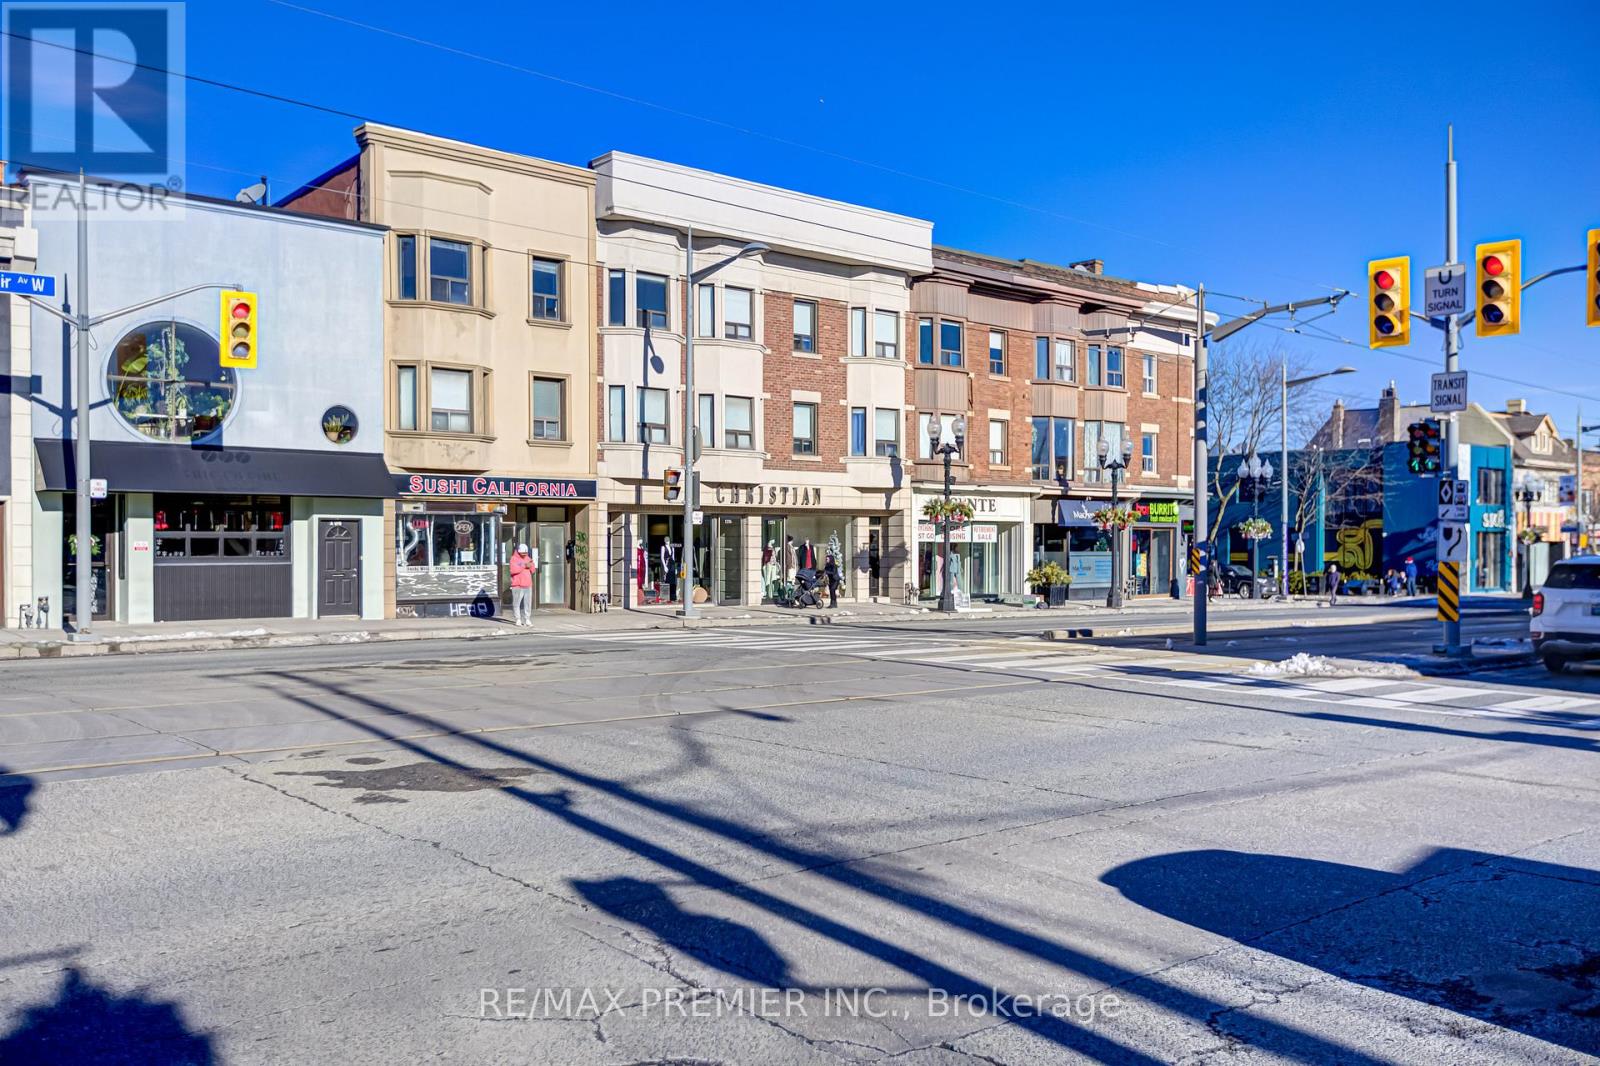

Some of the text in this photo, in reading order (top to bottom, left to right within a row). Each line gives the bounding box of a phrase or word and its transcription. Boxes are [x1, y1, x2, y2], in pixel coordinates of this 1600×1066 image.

[17, 276, 28, 285] Av
[31, 277, 45, 292] W
[1438, 270, 1452, 285] U
[1432, 287, 1458, 299] TURN
[1428, 299, 1462, 312] SIGNAL
[1433, 377, 1465, 391] TRANSIT
[1434, 394, 1462, 406] SIGNAL
[410, 475, 578, 497] SUSHI CALIFORNIA
[715, 486, 821, 506] CHRISTIAN
